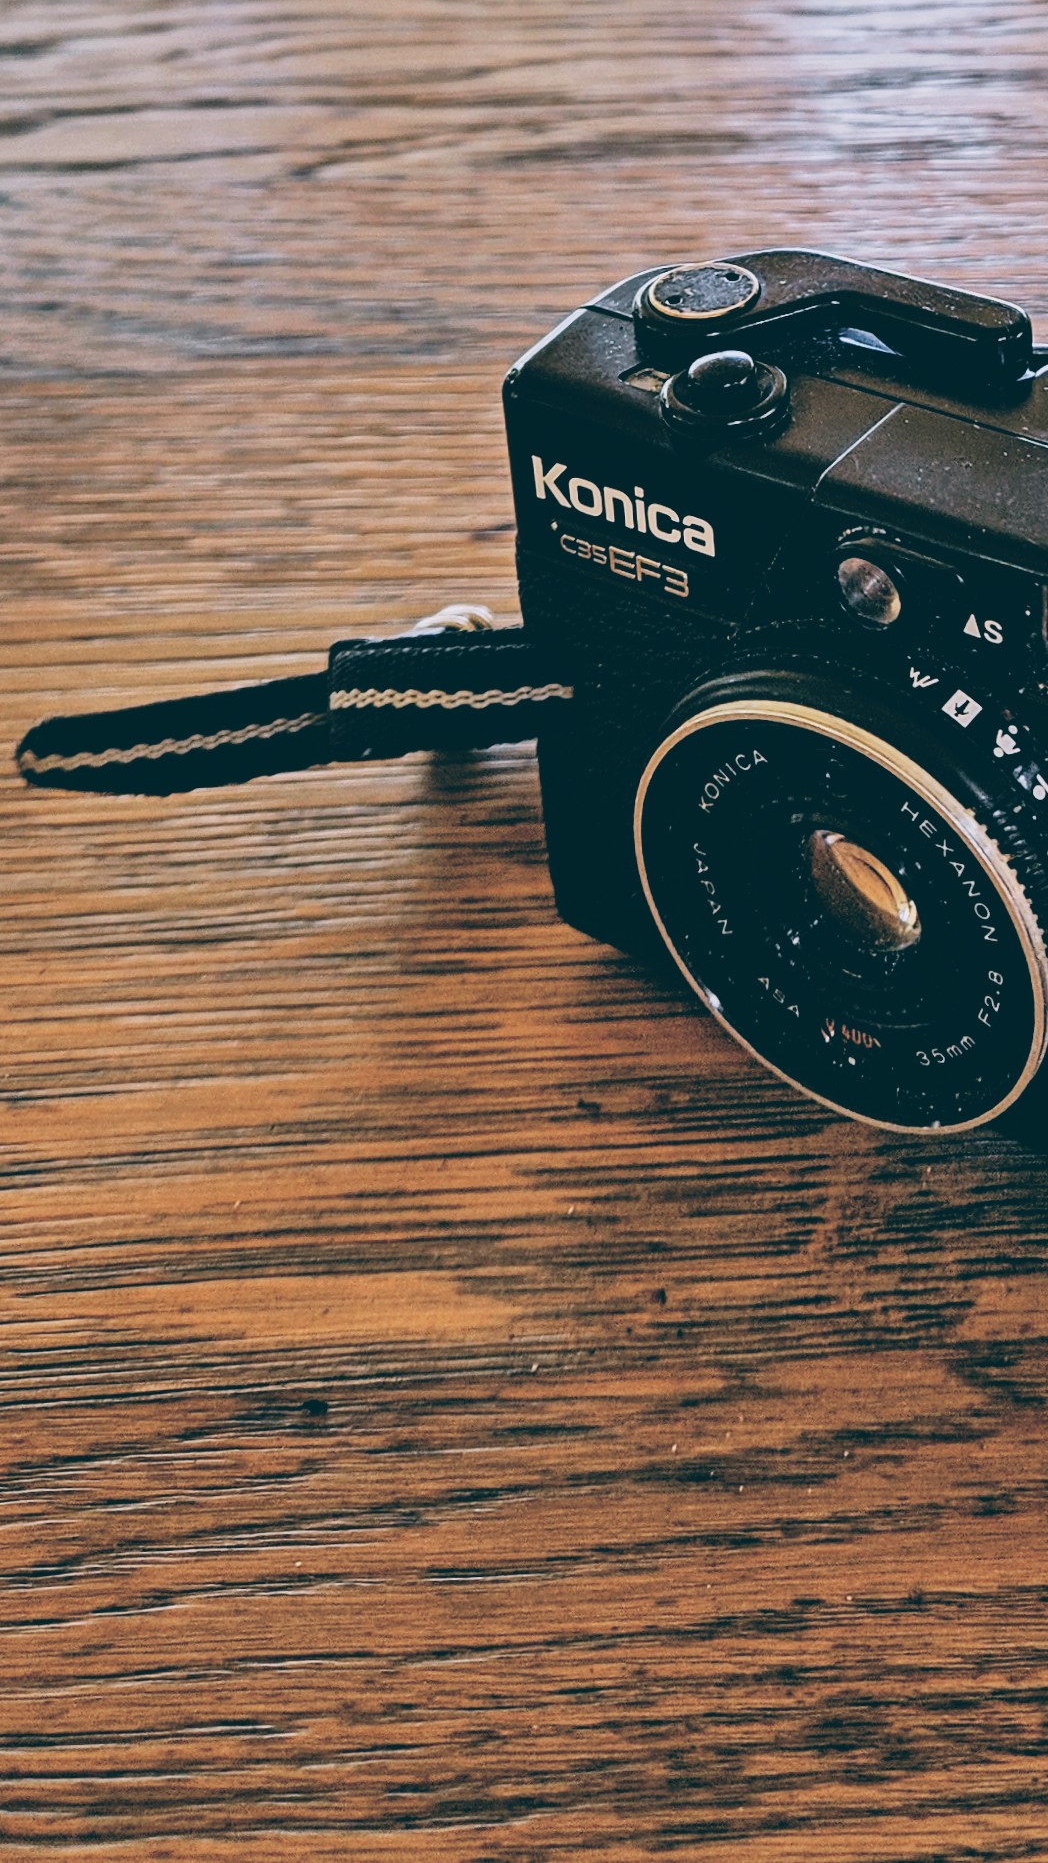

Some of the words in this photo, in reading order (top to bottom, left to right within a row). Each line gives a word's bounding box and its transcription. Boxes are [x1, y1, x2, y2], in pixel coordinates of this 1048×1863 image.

[531, 454, 716, 558] Konica
[693, 842, 734, 936] JAPAN
[698, 749, 769, 814] KONICA
[900, 801, 999, 943] HEXANON
[915, 1035, 976, 1067] 35mm
[977, 970, 1004, 1028] F2.8
